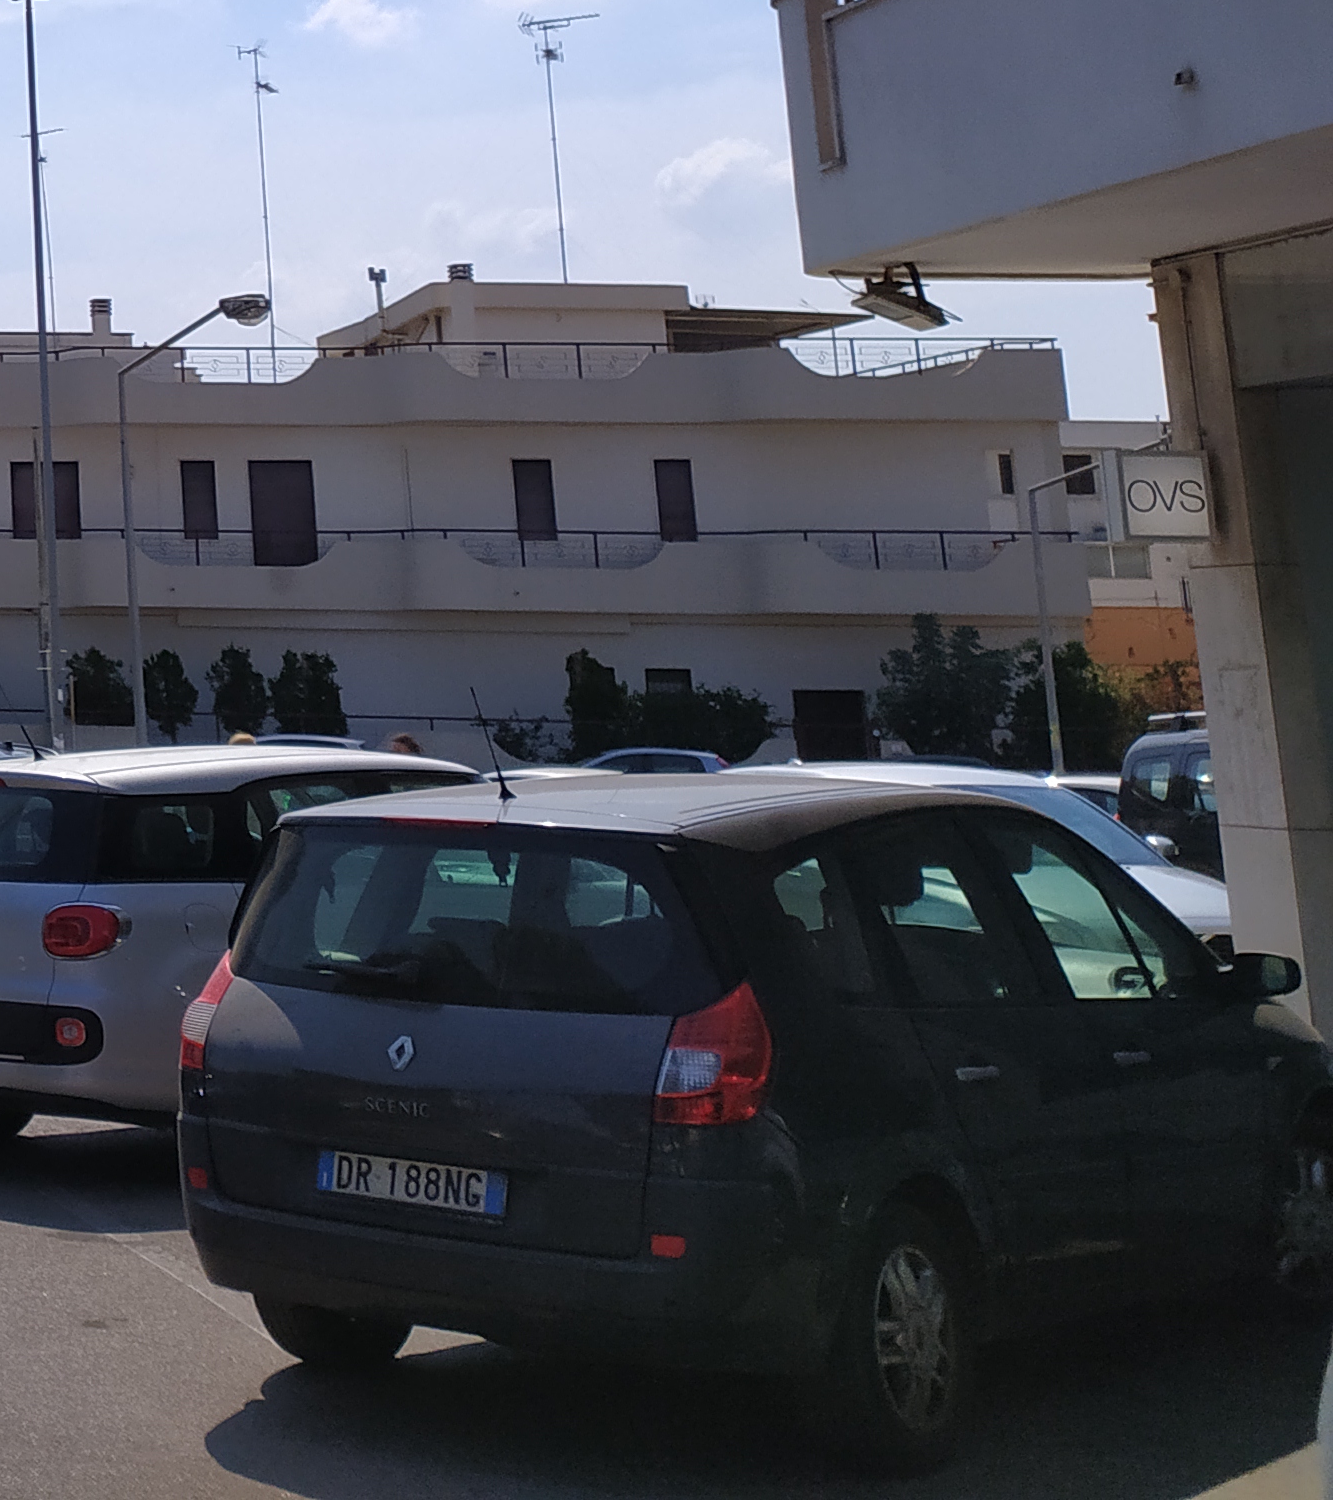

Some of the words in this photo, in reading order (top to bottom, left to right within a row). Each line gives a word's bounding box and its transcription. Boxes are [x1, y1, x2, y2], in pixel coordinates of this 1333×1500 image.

[1127, 479, 1206, 513] OVS
[336, 1154, 373, 1193] DR
[387, 1161, 483, 1208] 188NG
